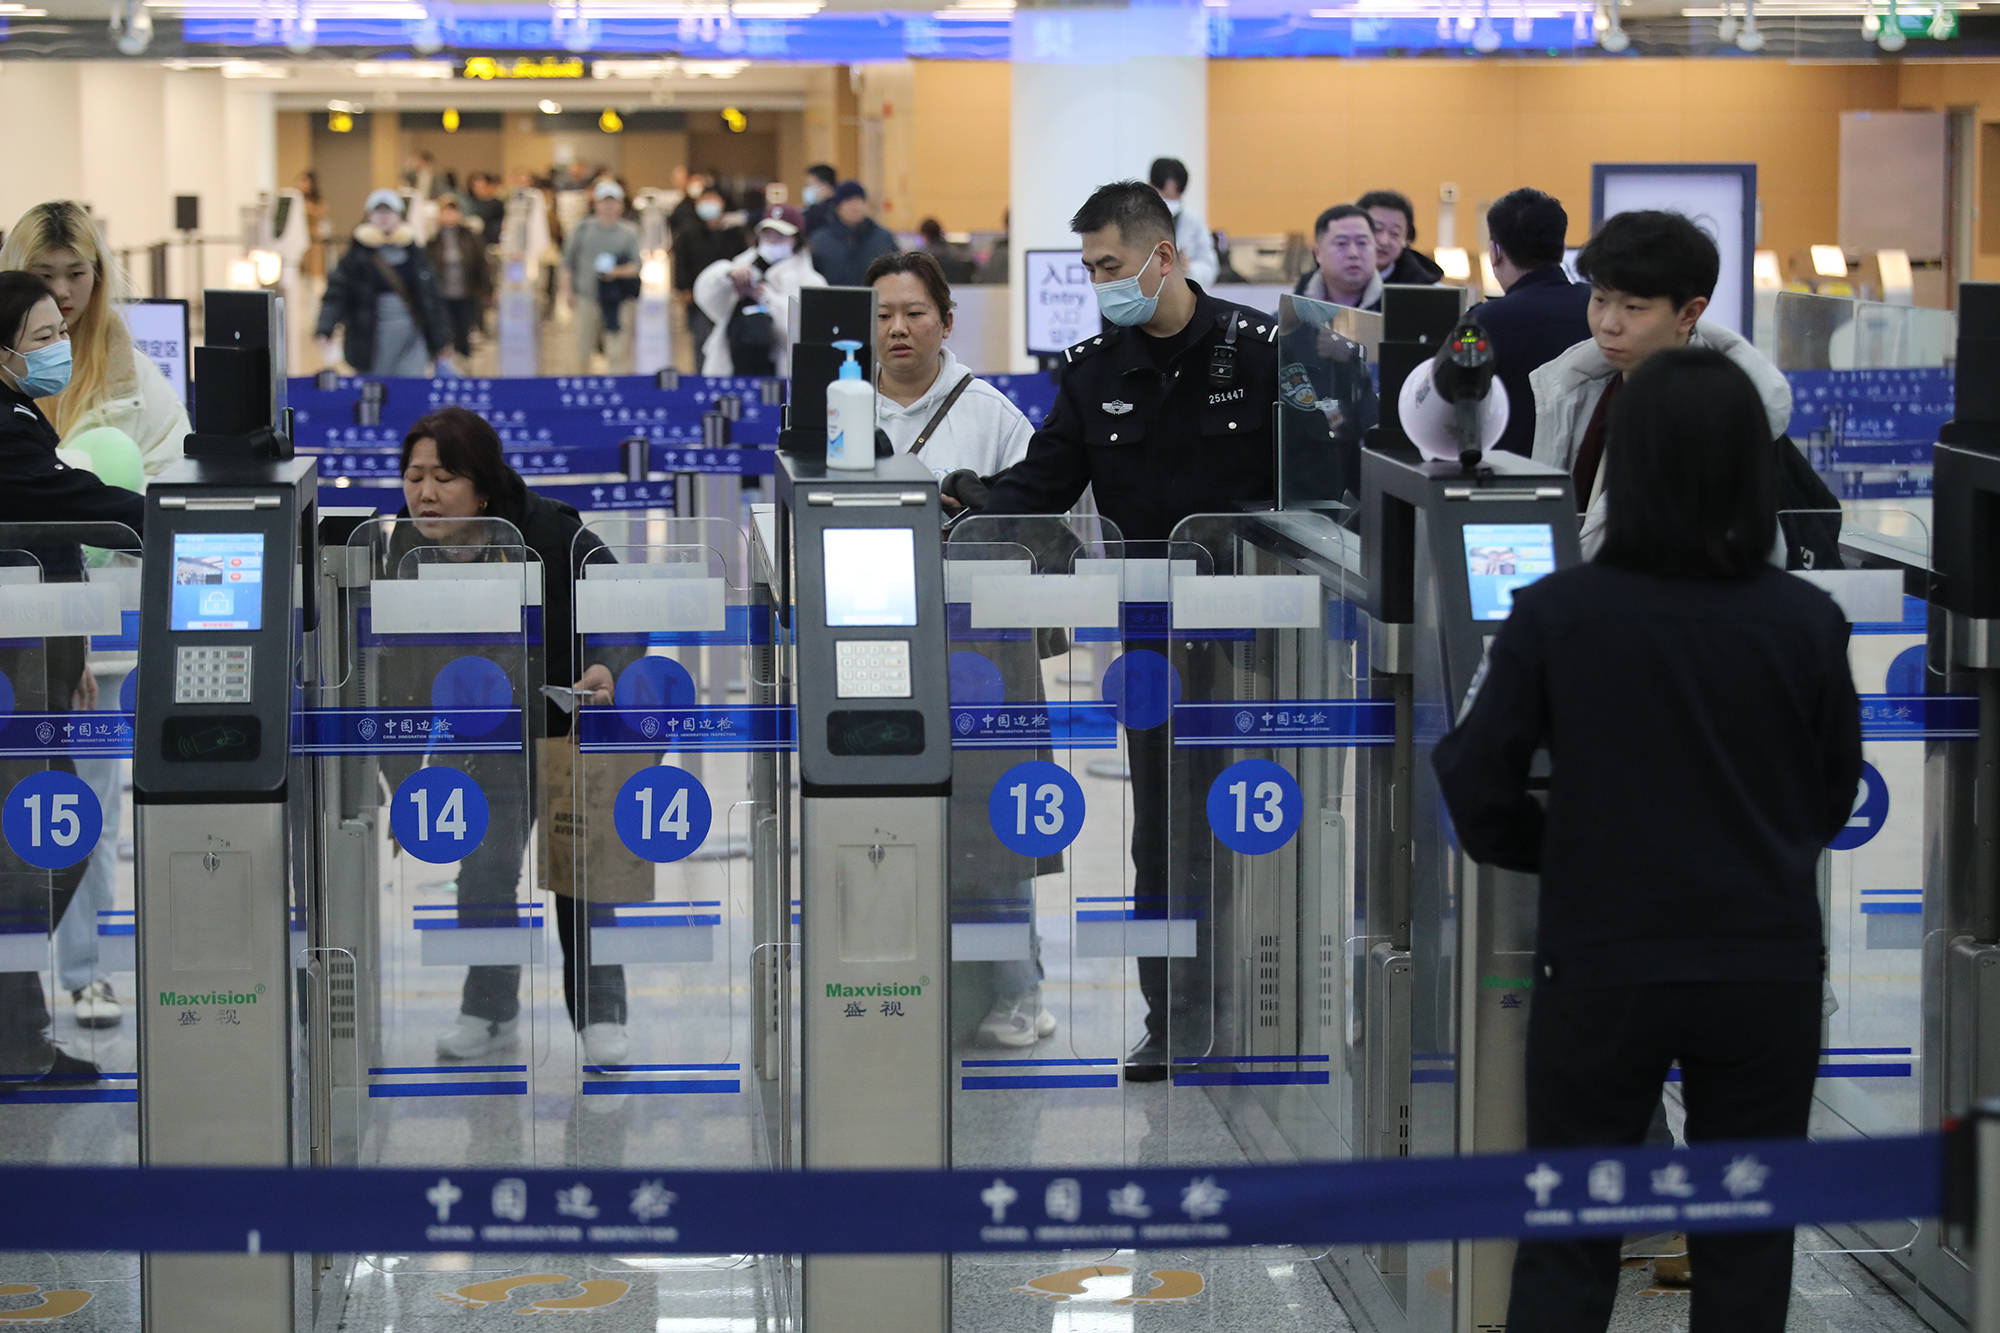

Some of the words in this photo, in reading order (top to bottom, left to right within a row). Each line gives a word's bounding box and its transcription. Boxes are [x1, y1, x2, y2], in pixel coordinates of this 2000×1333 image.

[1208, 388, 1245, 405] 251447
[384, 718, 453, 734] 中国边检
[667, 716, 734, 732] 中国边检
[982, 713, 1049, 728] 中国边检
[1261, 711, 1327, 726] 中国边检
[62, 722, 131, 738] 中国边检
[1009, 783, 1065, 835] 13
[1229, 781, 1284, 833] 13
[1845, 777, 1870, 827] 2
[23, 794, 81, 847] 15
[410, 788, 467, 841] 14
[635, 787, 690, 841] 14
[843, 1000, 905, 1018] 盛视
